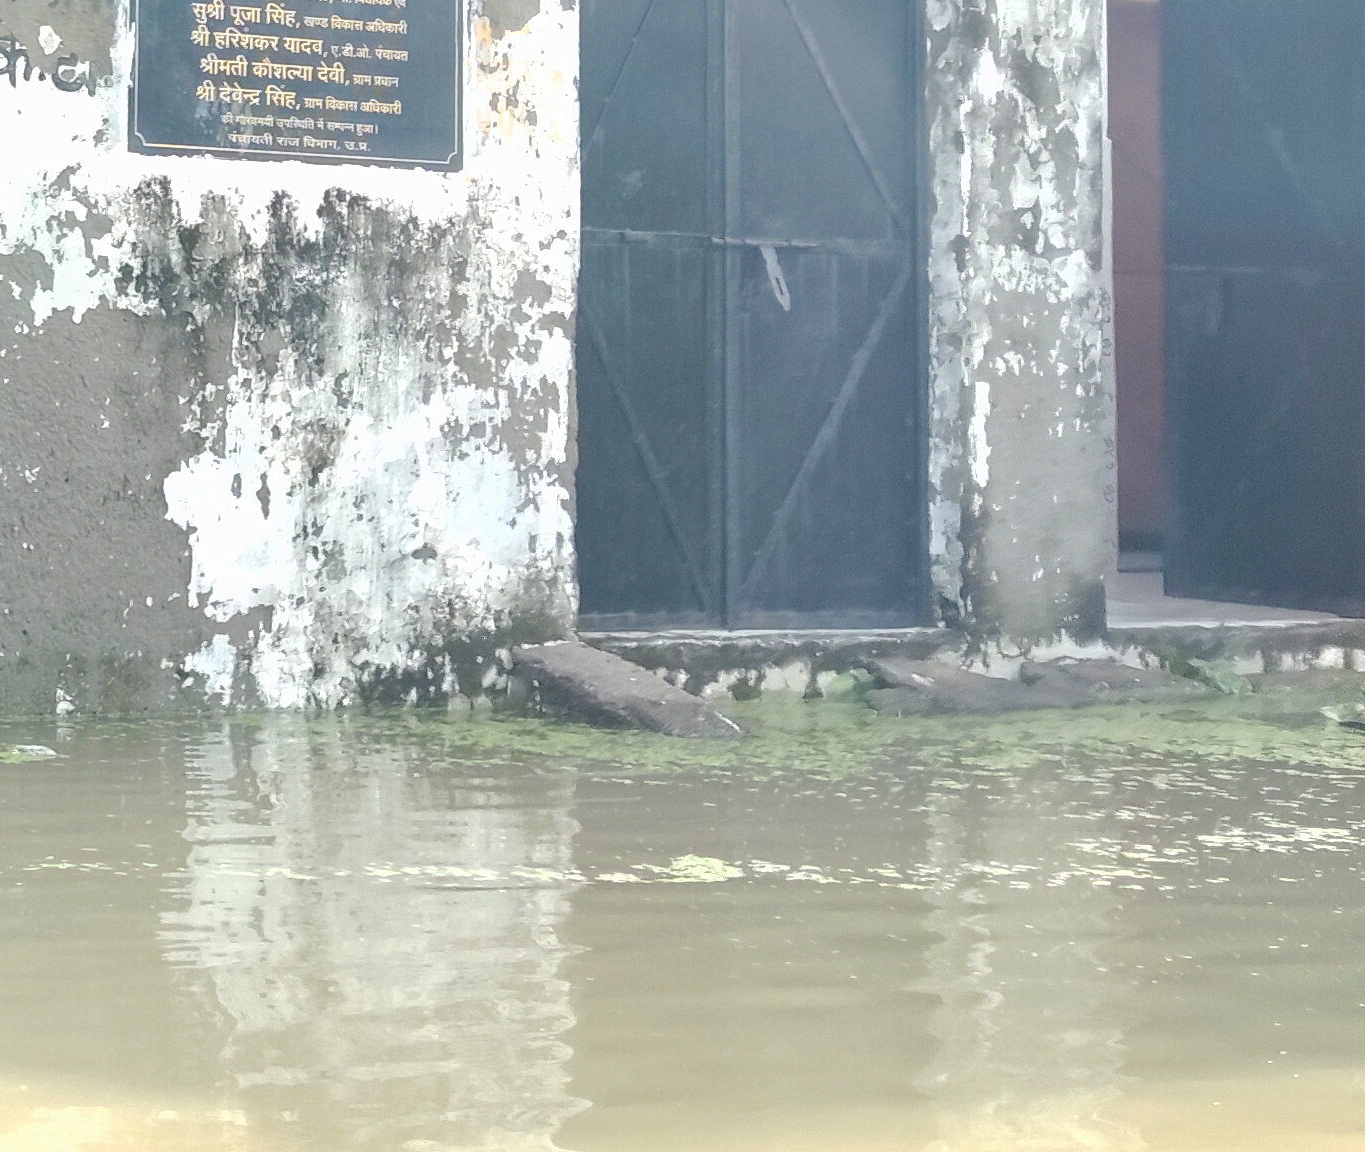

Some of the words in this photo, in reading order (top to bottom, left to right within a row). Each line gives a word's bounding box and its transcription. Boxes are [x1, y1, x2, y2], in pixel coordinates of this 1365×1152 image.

[229, 5, 262, 25] पूजा
[331, 15, 363, 31] विकास
[365, 18, 408, 35] अधिकारी
[190, 25, 210, 46] श्री
[213, 26, 280, 51] हरिशंकर
[199, 52, 248, 77] श्रीमती
[251, 56, 314, 82] कौशल्या
[352, 73, 372, 86] ग्राम
[196, 79, 216, 102] श्री
[218, 81, 263, 106] देवेन्द्र
[303, 97, 323, 109] ग्राम
[325, 95, 358, 112] विकास
[360, 99, 402, 115] अधिकारी
